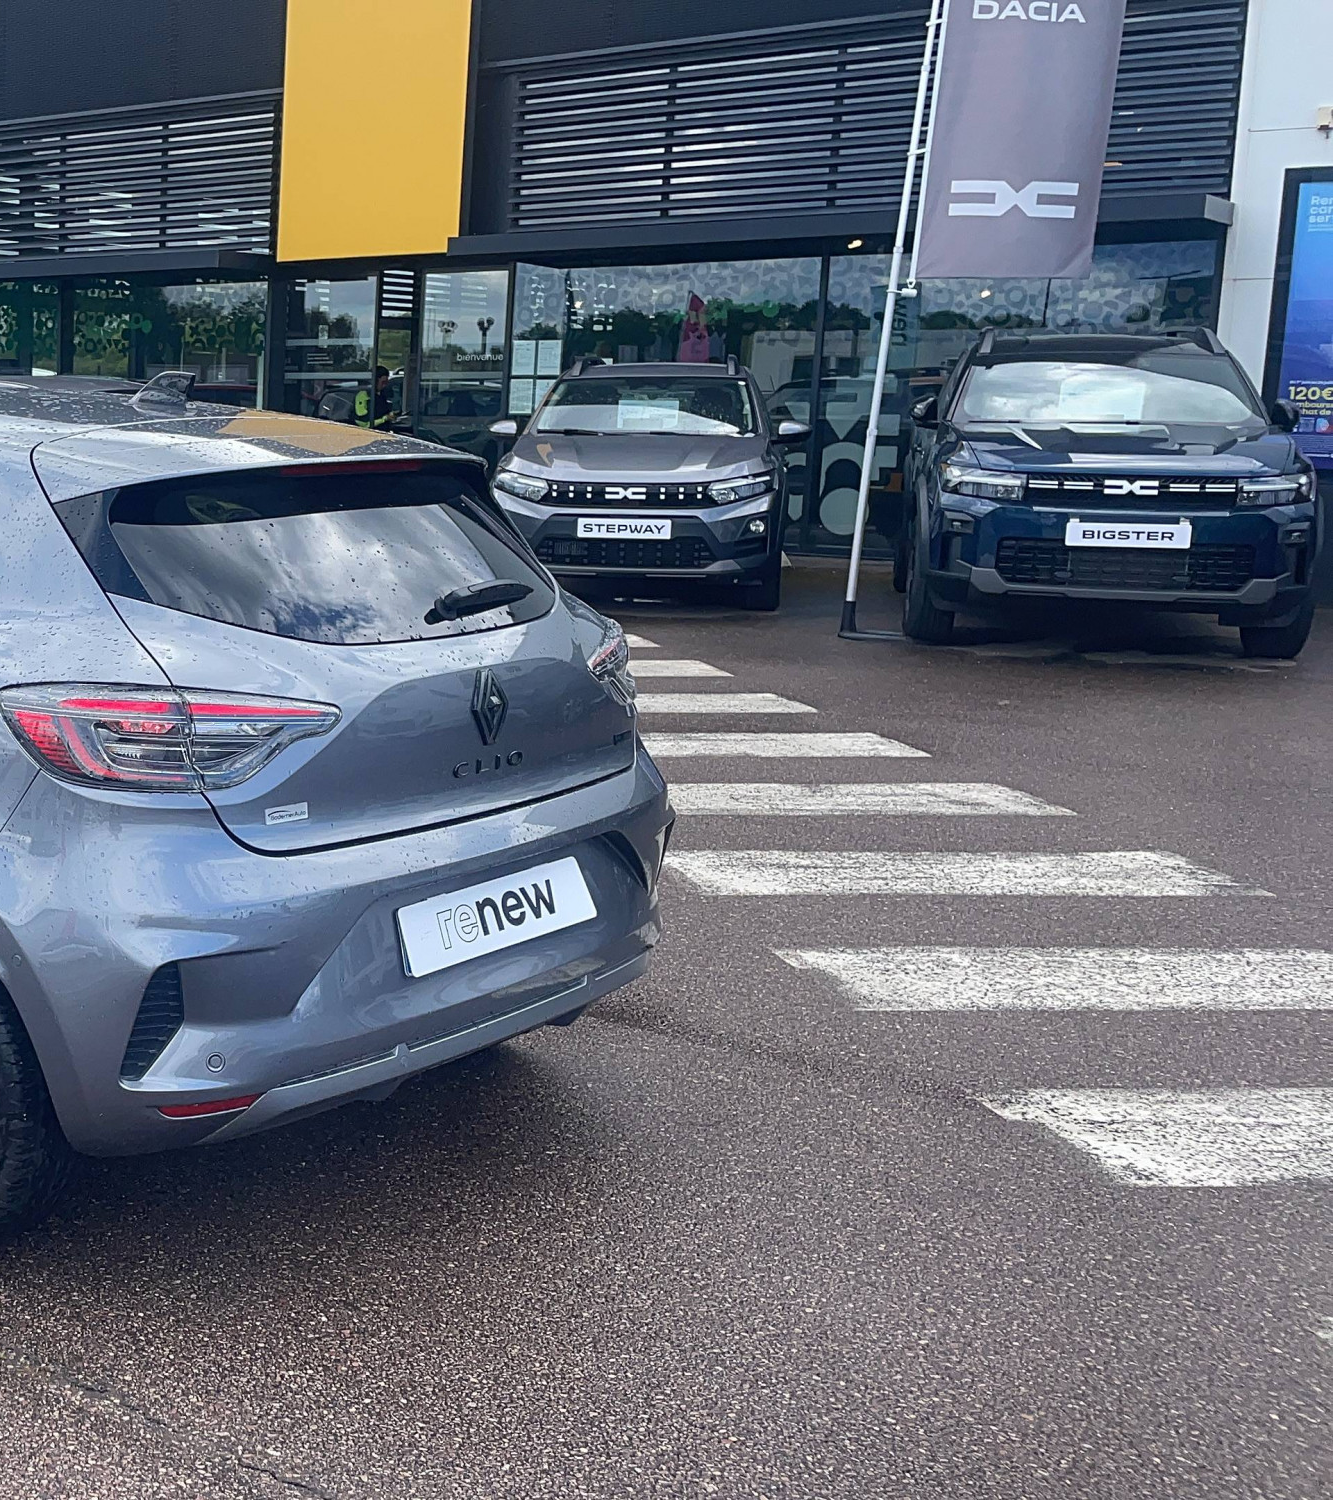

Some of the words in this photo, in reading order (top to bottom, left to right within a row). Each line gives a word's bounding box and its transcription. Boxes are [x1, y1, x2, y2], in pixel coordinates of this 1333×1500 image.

[972, 0, 1087, 23] DACIA
[457, 353, 504, 361] bienvenue
[583, 523, 666, 534] STEPWAY
[1082, 530, 1175, 541] BIGSTER
[453, 750, 523, 779] CLIO
[436, 879, 556, 950] renew
